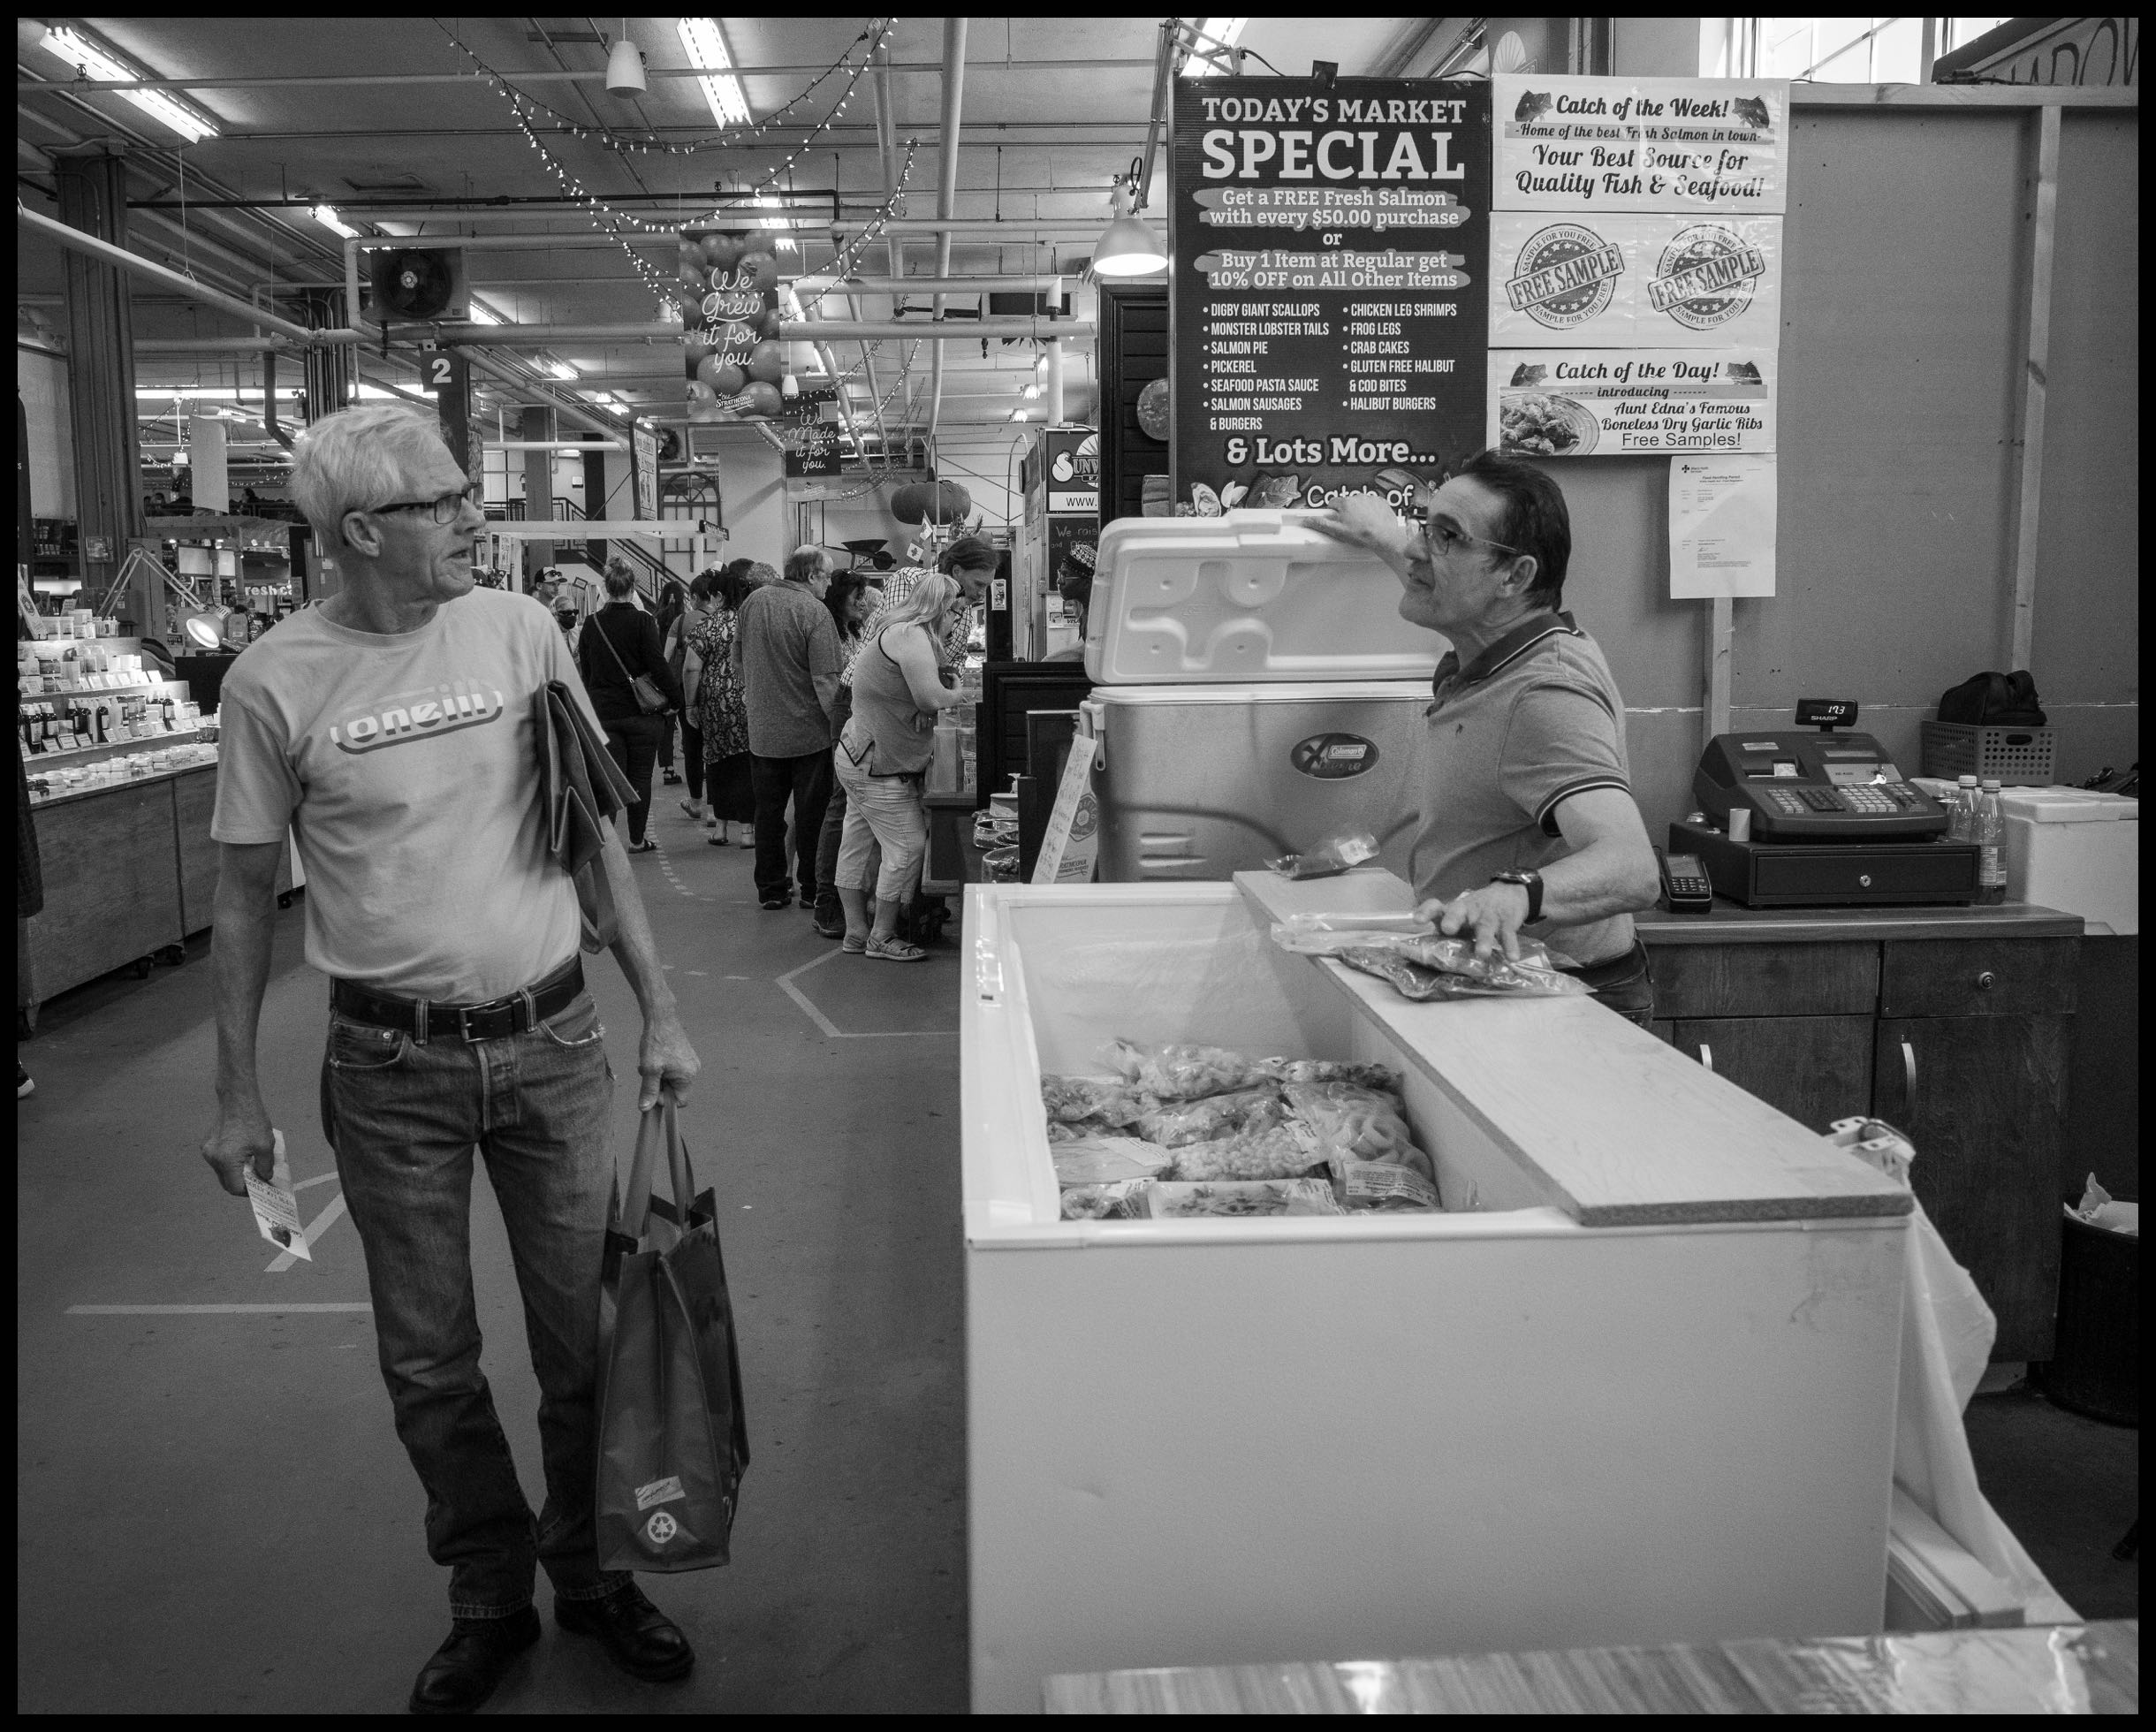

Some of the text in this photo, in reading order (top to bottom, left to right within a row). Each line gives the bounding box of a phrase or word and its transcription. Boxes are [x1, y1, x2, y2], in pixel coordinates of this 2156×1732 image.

[1202, 96, 1467, 124] TODAY'S MARKET
[1555, 95, 1730, 121] Catch of the Week!
[1558, 125, 1571, 141] of
[1574, 125, 1593, 138] the
[1597, 125, 1620, 140] best
[1625, 125, 1657, 141] Frsh
[1661, 126, 1709, 141] Salmon
[1712, 128, 1724, 141] in
[1202, 129, 1465, 179] SPECIAL
[1531, 144, 1749, 176] Your Best Source for
[1515, 170, 1765, 201] Quality Fish & Seafood!
[1222, 190, 1446, 207] Get a FREE Fresh Salmon
[1209, 209, 1460, 230] with every $50.00 purchase
[1322, 233, 1343, 246] or
[1522, 241, 1543, 273] SAMPLE
[1541, 232, 1557, 244] FOR
[1576, 233, 1597, 249] FREE
[1221, 252, 1447, 274] Buy 1 Item at Regular get
[710, 267, 754, 291] We
[1211, 270, 1458, 287] 10% OFF on All Other Items
[1512, 248, 1619, 306] FREE SAMPLE
[1653, 249, 1760, 306] FREE SAMPLE
[702, 292, 761, 323] Grew
[1211, 303, 1321, 317] DIGBY GIANT SCALLOPS
[1350, 303, 1457, 317] CHICKEN LEG SHRIMPS
[1533, 281, 1609, 324] SAMPLE FOR YOU FREE
[1675, 306, 1706, 324] SAMPLE
[1707, 314, 1725, 323] FOR
[1724, 304, 1740, 318] YOU
[702, 323, 763, 353] it for
[1211, 323, 1330, 336] MONSTER LOBSTER TAILS
[1350, 323, 1401, 336] FROG LEGS
[1211, 341, 1269, 354] SALMON PIE
[1350, 341, 1410, 354] CRAB CAKES
[431, 358, 452, 384] 2
[714, 352, 755, 374] you.
[1211, 361, 1257, 374] PICKEREL
[1350, 360, 1455, 373] GLUTEN FREE HALIBUT
[1555, 361, 1720, 384] Catch of the Day!
[1211, 379, 1319, 392] SEAFOOD PASTA SAUCE
[1349, 379, 1407, 392] & COD BITES
[1597, 386, 1671, 400] introducing
[1211, 398, 1302, 411] SALMON SAUSAGES
[1350, 398, 1436, 411] HALIBUT BURGERS
[1613, 400, 1751, 415] Aunt Edna's Famous
[800, 412, 824, 426] We
[1210, 417, 1263, 430] & BURGERS
[1600, 416, 1763, 433] Boneless Dry Garlic Ribs
[788, 426, 836, 443] Made
[1621, 430, 1742, 448] Free Samples!
[795, 444, 831, 461] it for
[1226, 437, 1436, 464] & Lots More...
[802, 460, 826, 475] you.
[1386, 484, 1414, 507] of
[1055, 523, 1072, 537] We
[244, 585, 277, 596] resh
[1331, 747, 1358, 756] Coleman
